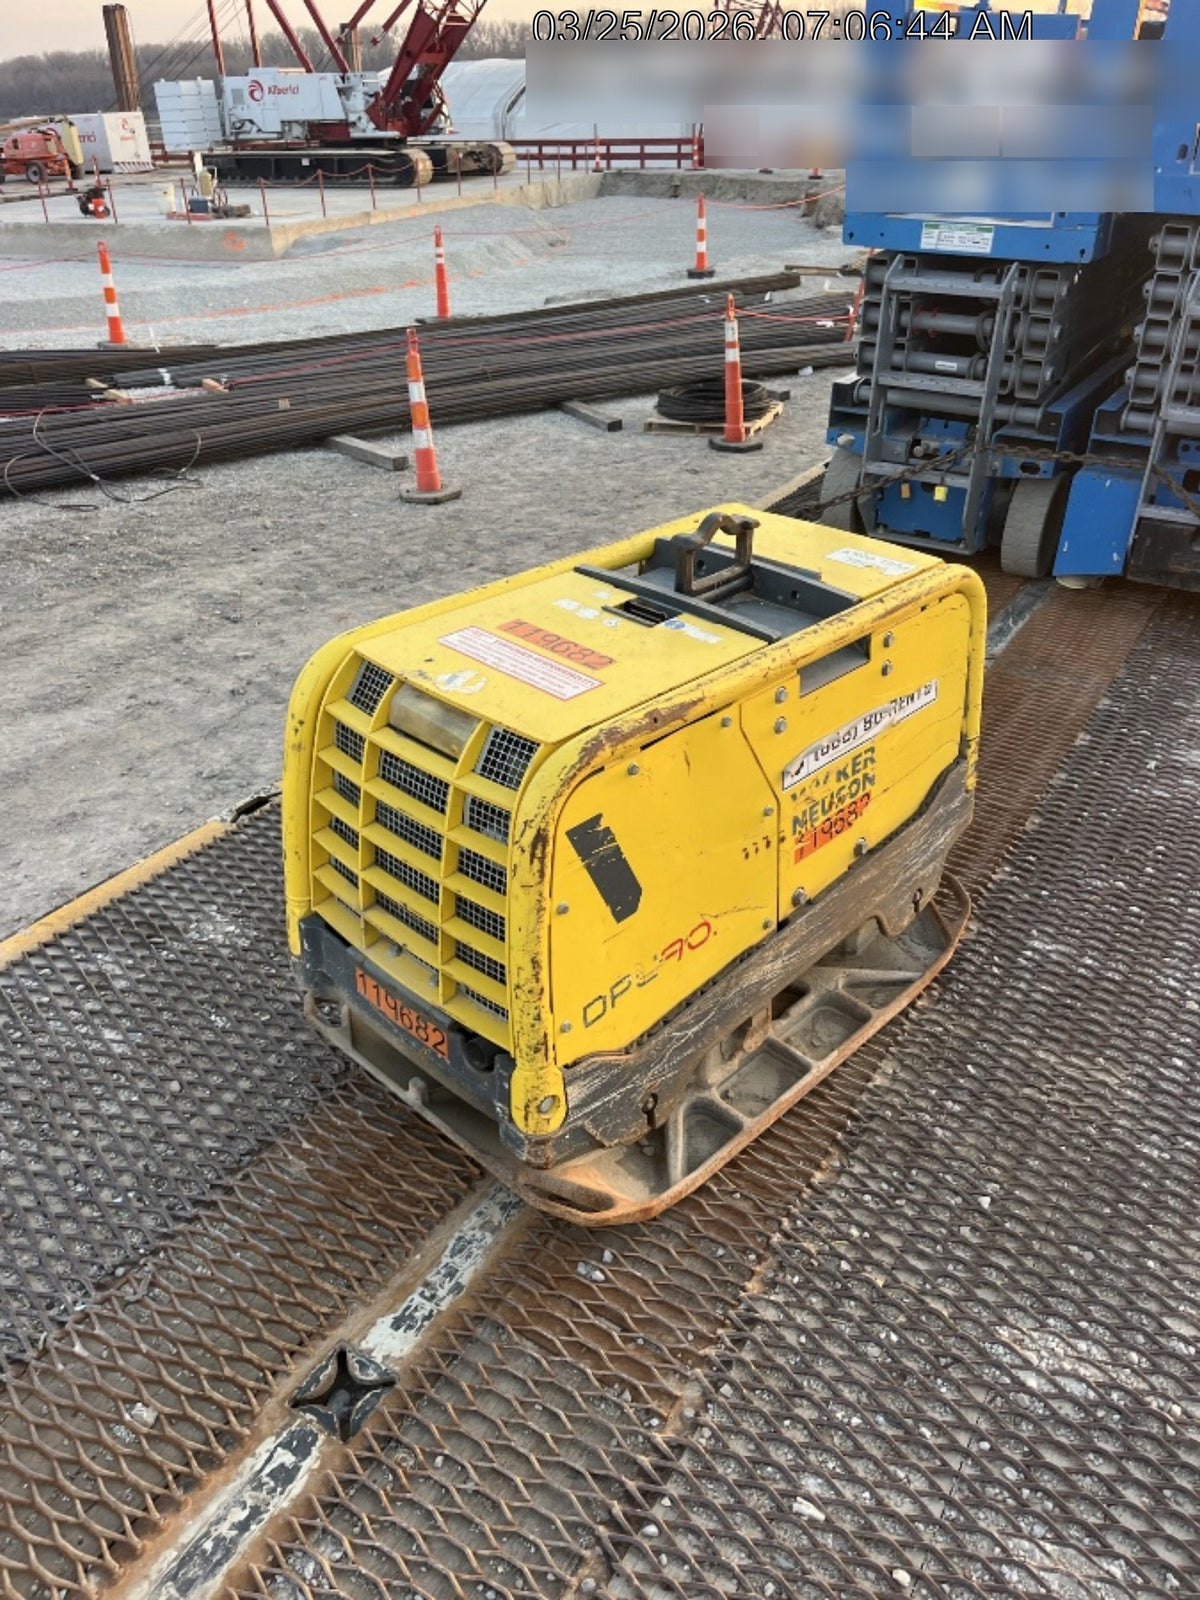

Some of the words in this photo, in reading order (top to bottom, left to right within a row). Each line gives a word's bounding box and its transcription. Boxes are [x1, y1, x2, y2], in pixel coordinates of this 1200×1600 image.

[503, 620, 615, 670] 119682
[790, 746, 876, 801] KER
[792, 772, 876, 835] NEUSON
[358, 973, 447, 1057] 119682
